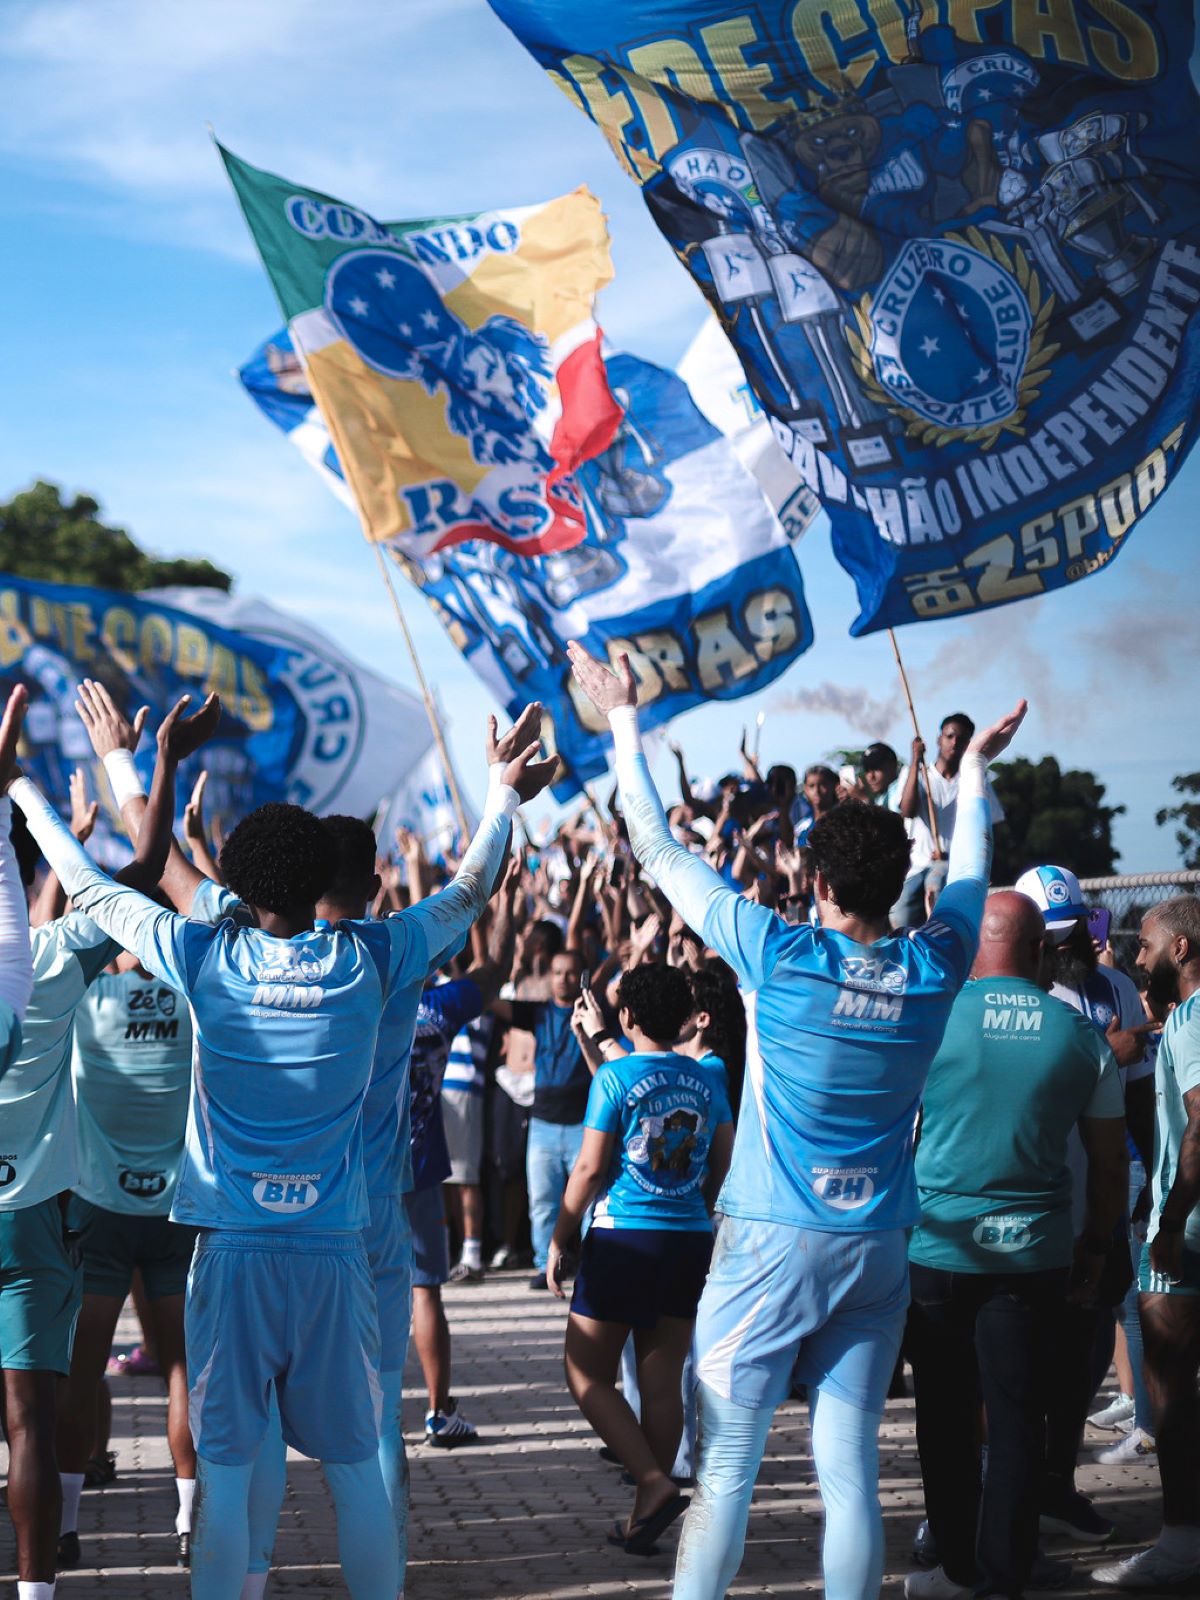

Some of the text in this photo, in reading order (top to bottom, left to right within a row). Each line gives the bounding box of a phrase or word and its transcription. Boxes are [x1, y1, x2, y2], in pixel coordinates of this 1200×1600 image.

[876, 243, 973, 338] CRUZEIRO
[128, 988, 157, 1010] Zé
[984, 993, 1041, 1008] CIMED
[982, 1008, 1043, 1032] MM
[983, 1031, 1009, 1041] Aluguel
[262, 1180, 309, 1204] BH
[821, 1176, 868, 1201] BH
